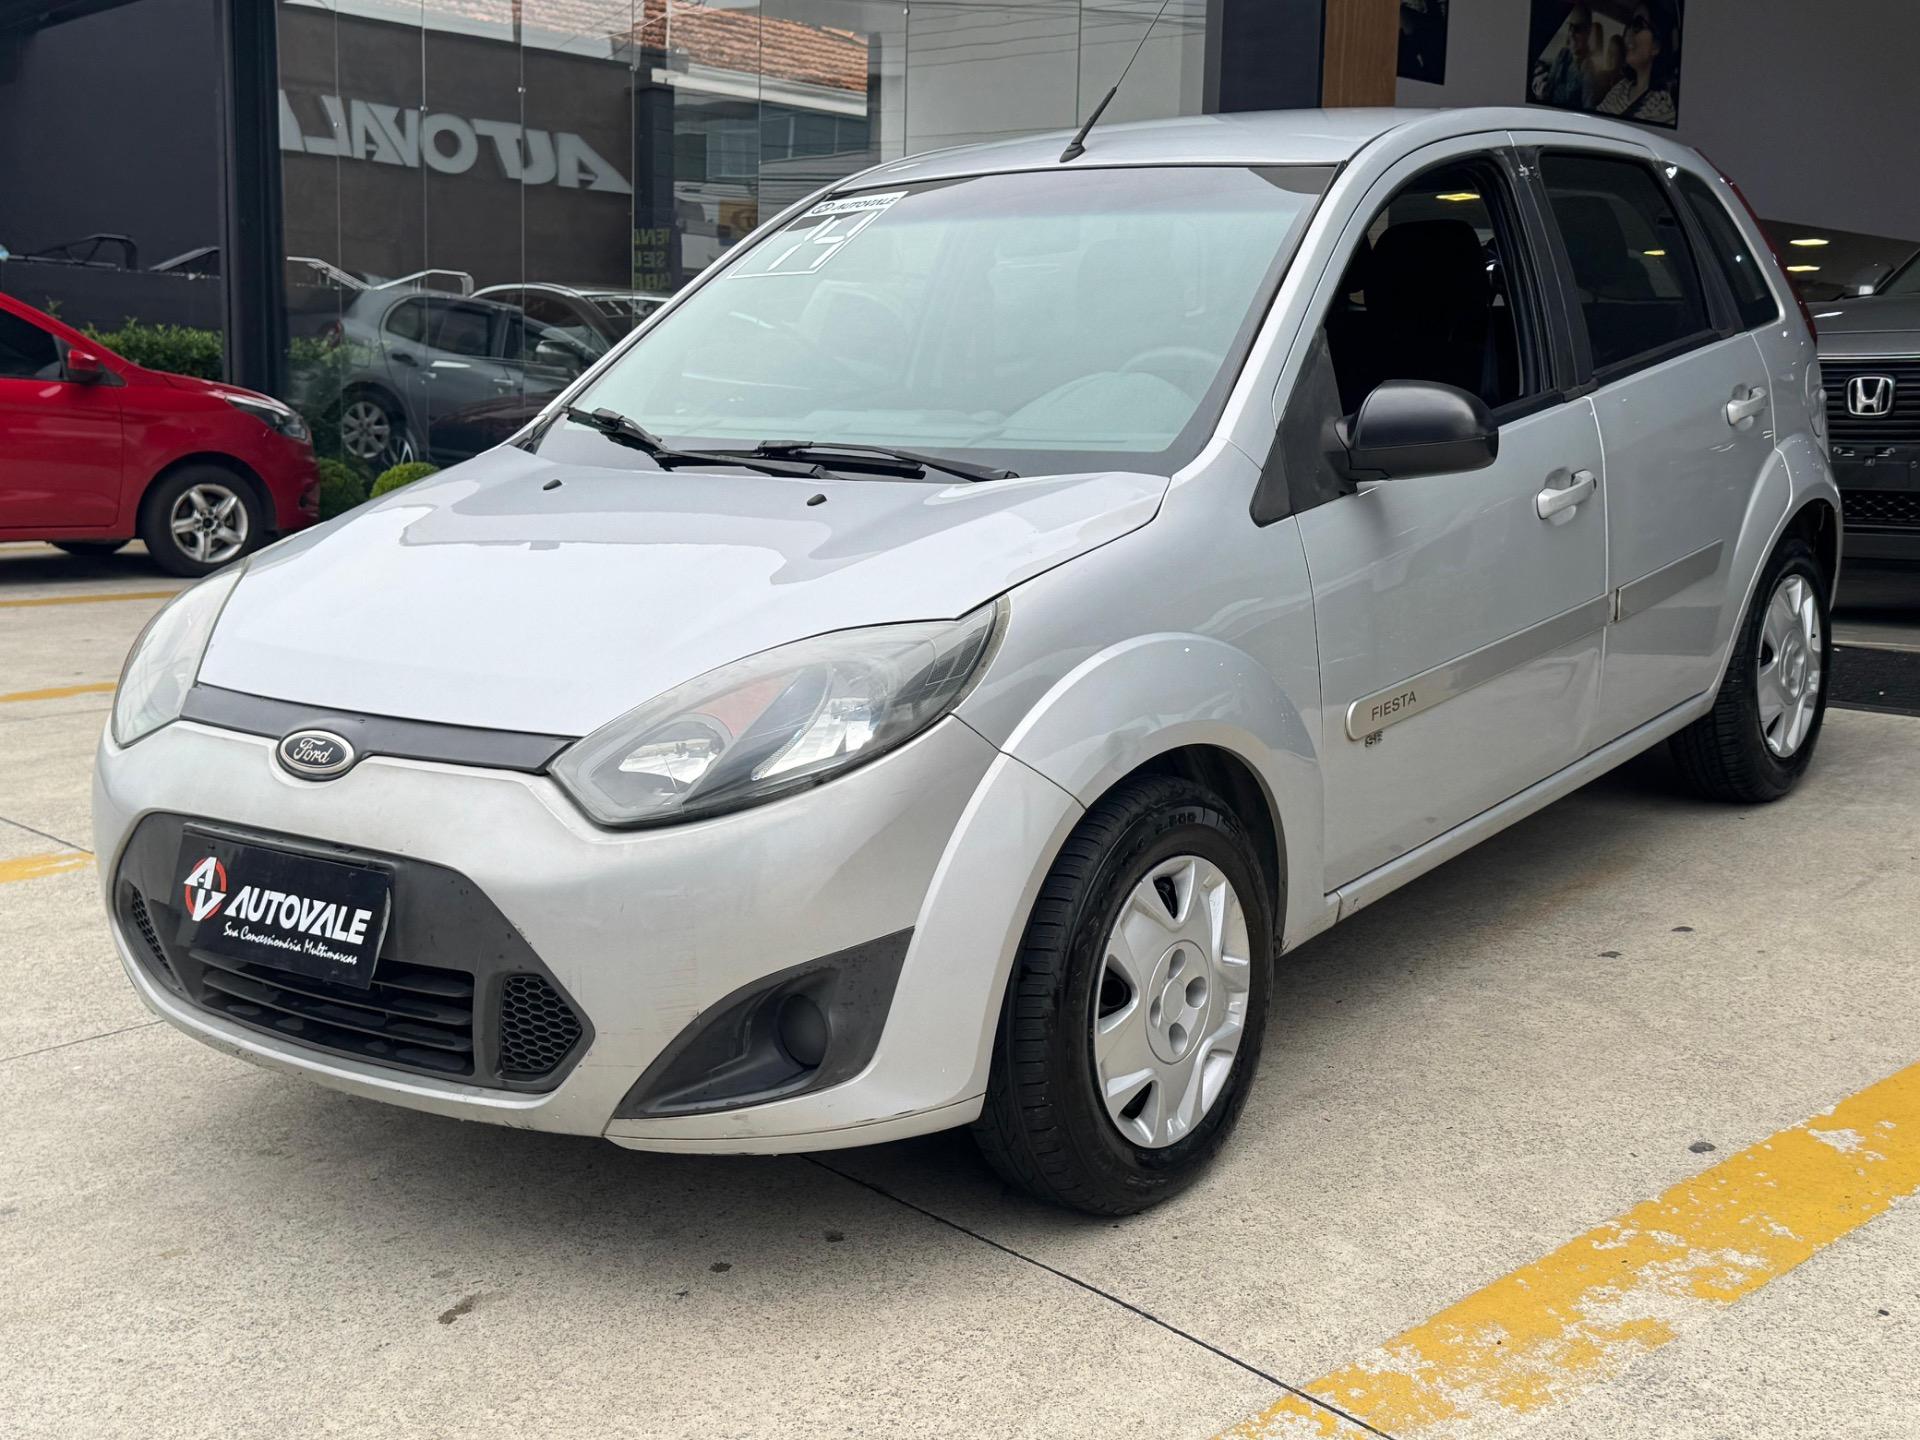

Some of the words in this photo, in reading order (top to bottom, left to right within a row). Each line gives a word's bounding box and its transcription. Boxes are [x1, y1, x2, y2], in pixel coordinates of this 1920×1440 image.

[1370, 690, 1418, 721] FIESTA
[293, 737, 334, 764] Ford
[223, 885, 373, 945] AUTOVALE
[223, 921, 239, 937] Sua
[303, 938, 358, 966] Multimarcas
